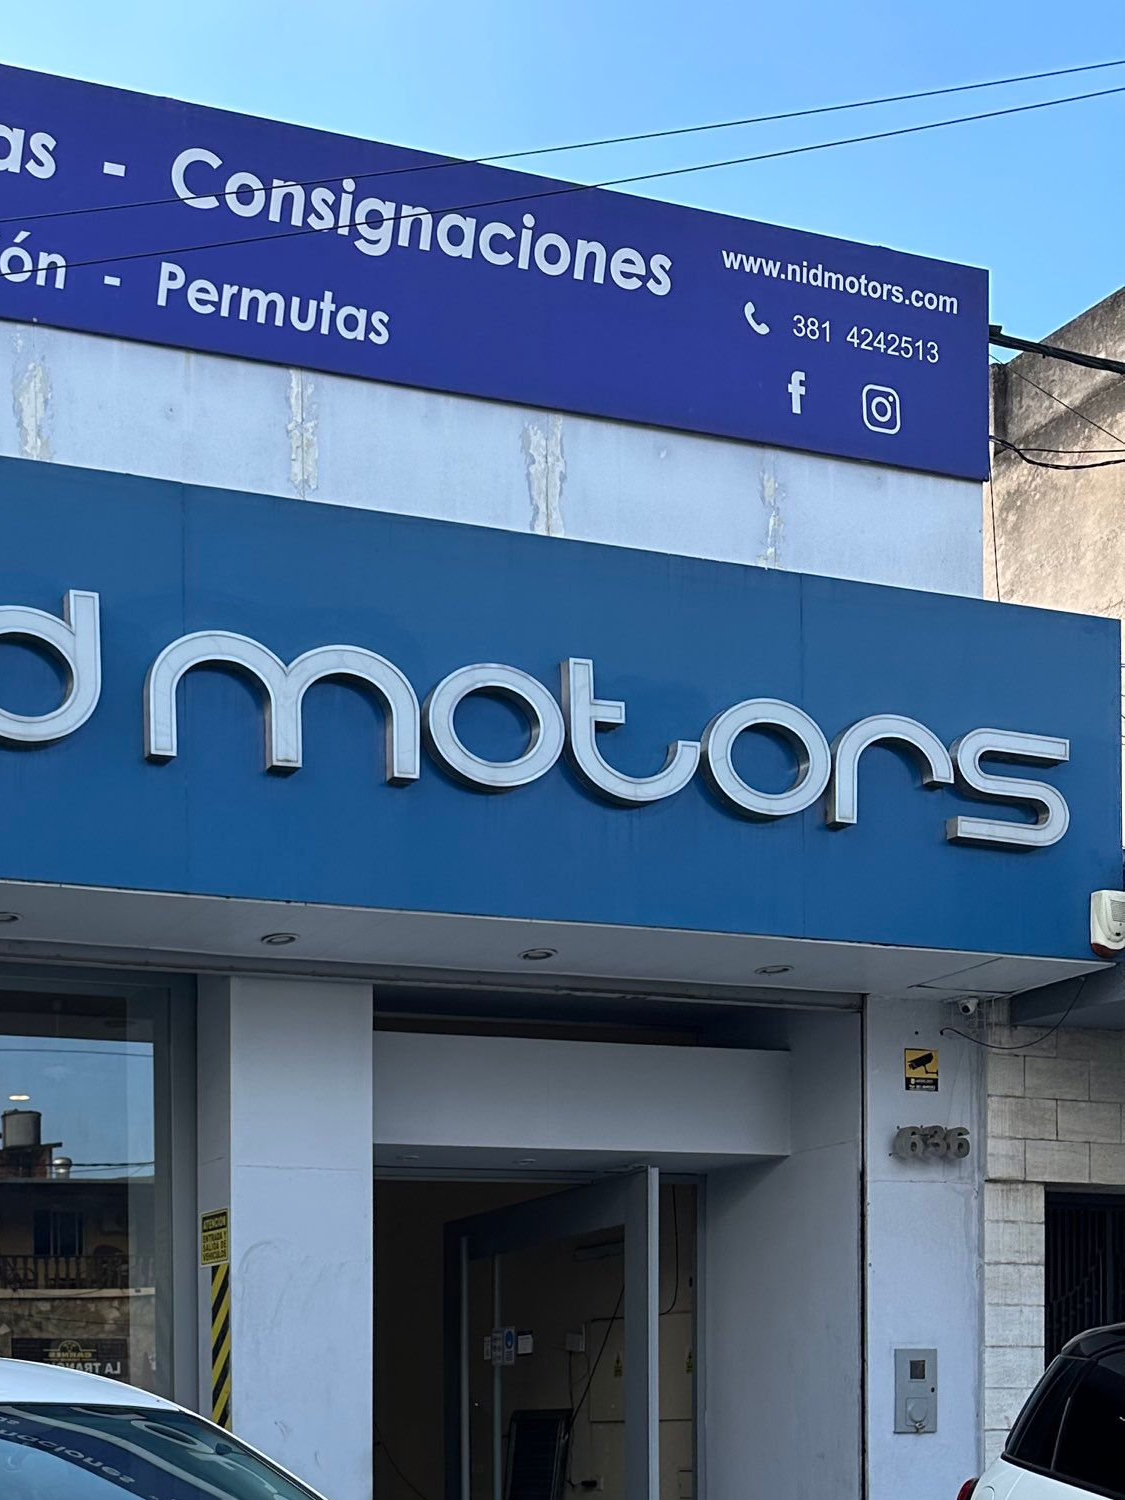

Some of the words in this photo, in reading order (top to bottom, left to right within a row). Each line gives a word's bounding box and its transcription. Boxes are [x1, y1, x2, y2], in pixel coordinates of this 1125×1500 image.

[169, 146, 675, 297] Consignaciones
[156, 260, 392, 347] Permutas
[721, 249, 959, 315] www.nidmotors.com
[792, 313, 834, 345] 381
[845, 326, 941, 365] 4242513
[143, 629, 1072, 852] motors
[894, 1125, 971, 1160] 636
